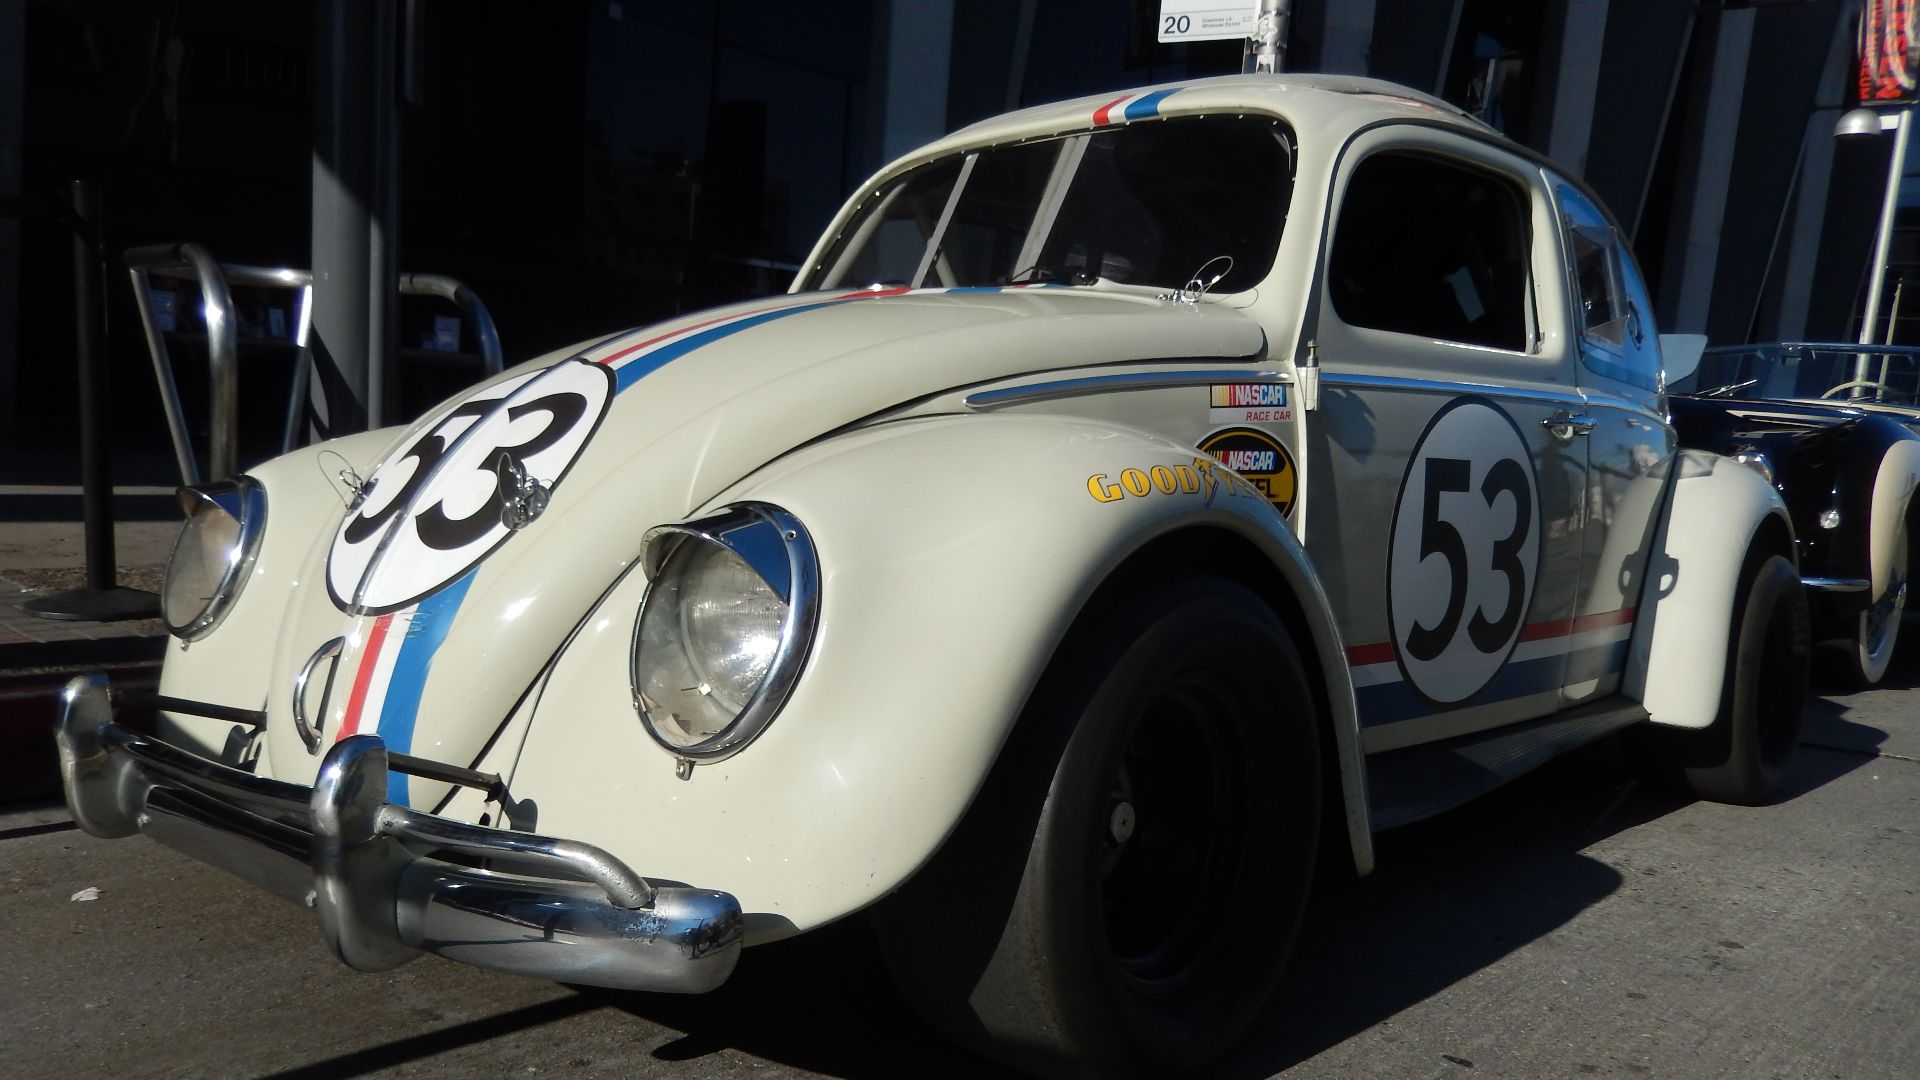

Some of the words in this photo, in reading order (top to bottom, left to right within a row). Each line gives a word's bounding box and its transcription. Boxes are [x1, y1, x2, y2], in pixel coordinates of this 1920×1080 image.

[1164, 15, 1190, 34] 20
[1235, 385, 1283, 405] NASCAR
[1245, 411, 1270, 421] RACE
[1273, 411, 1291, 421] CAR
[1228, 451, 1274, 471] NASCAR
[344, 392, 588, 551] 53
[1405, 457, 1532, 662] 53
